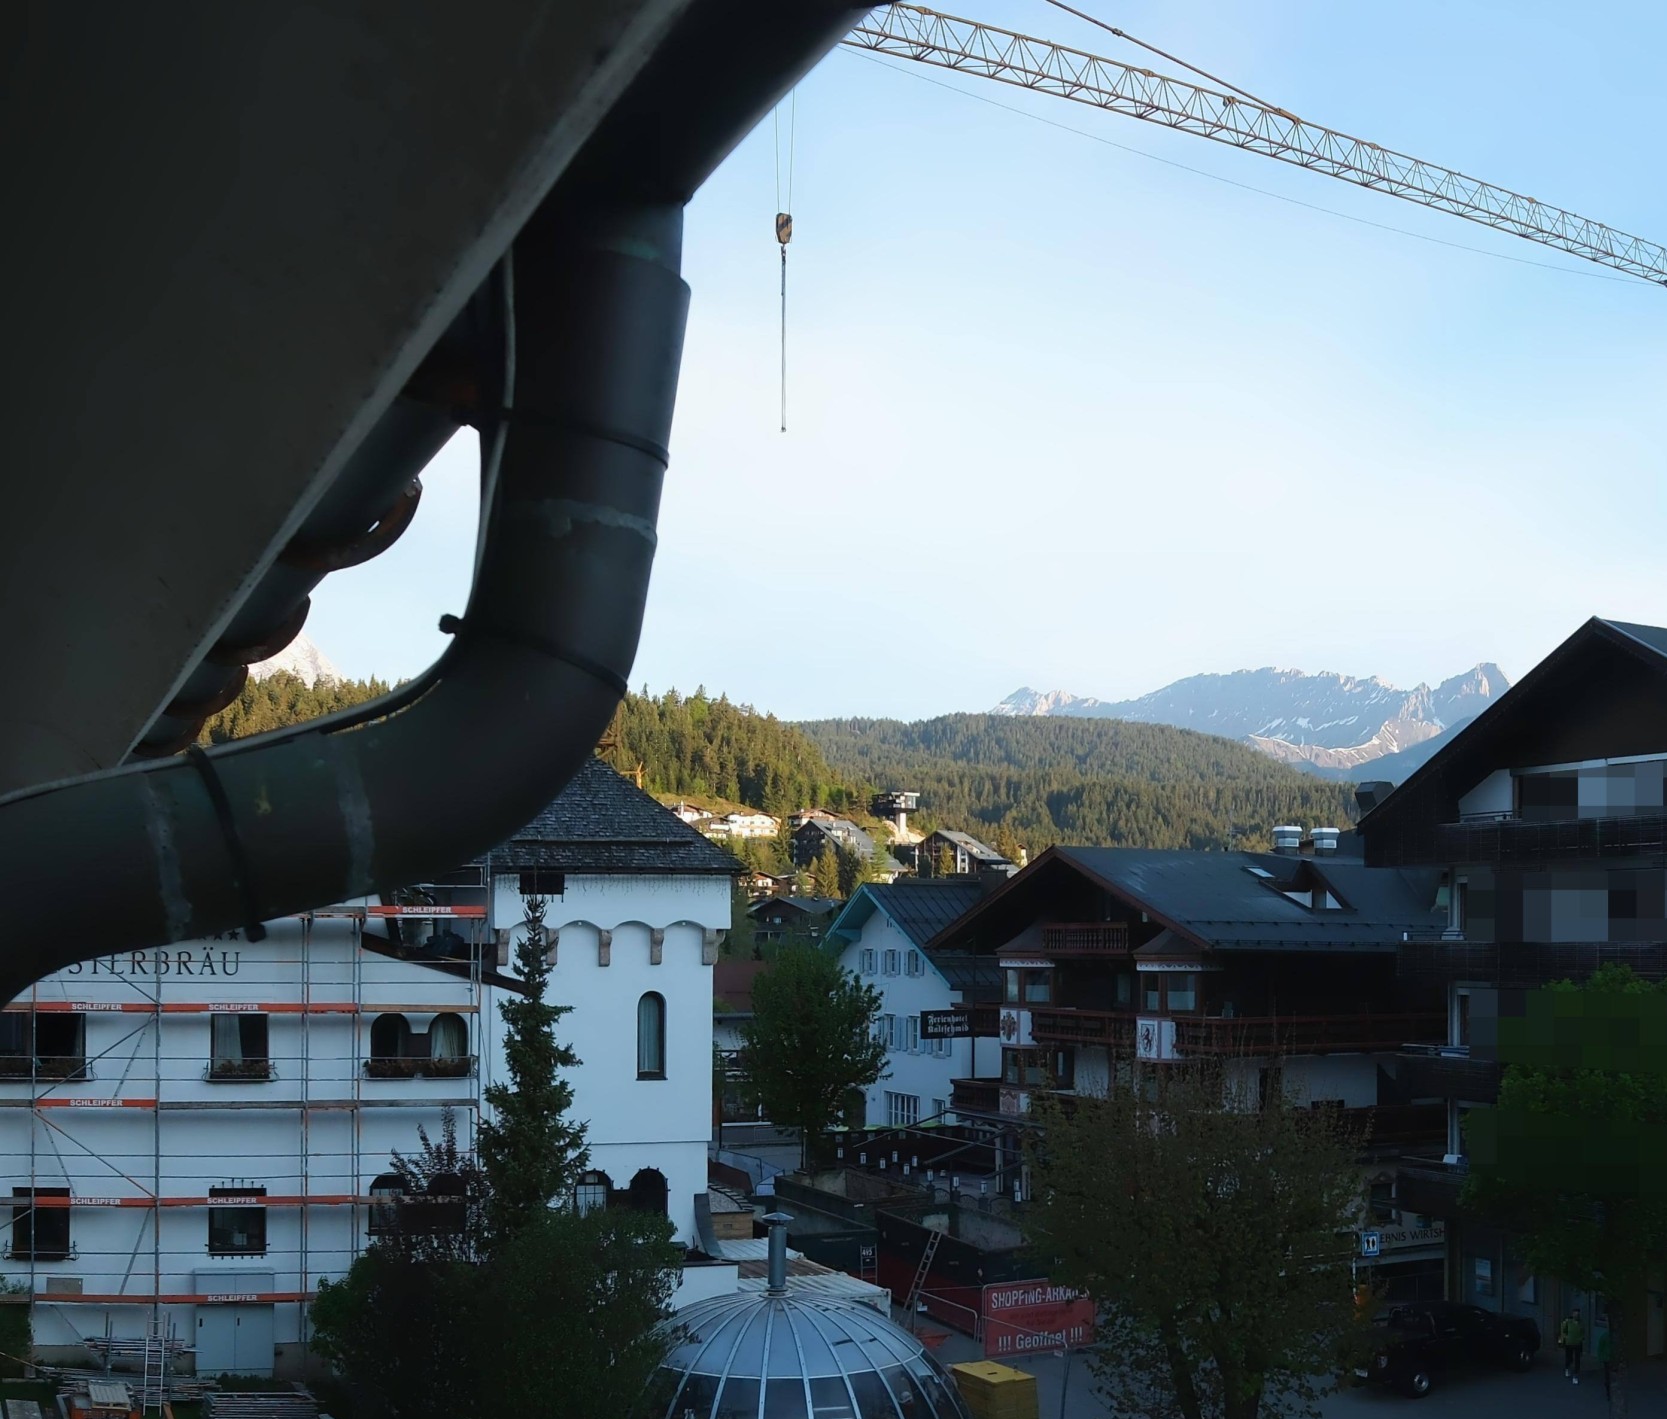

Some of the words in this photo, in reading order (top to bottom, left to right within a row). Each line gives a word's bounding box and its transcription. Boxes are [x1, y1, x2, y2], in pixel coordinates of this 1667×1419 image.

[402, 906, 452, 914] SCHLEIPFER
[71, 1003, 122, 1011] SCHLEIPFER
[208, 1003, 259, 1011] SCHLEIPFER
[69, 1099, 123, 1107] SCHLEIPFER
[207, 1197, 257, 1205] SCHLEIPFER
[207, 1294, 259, 1302] SCHLEIPFER
